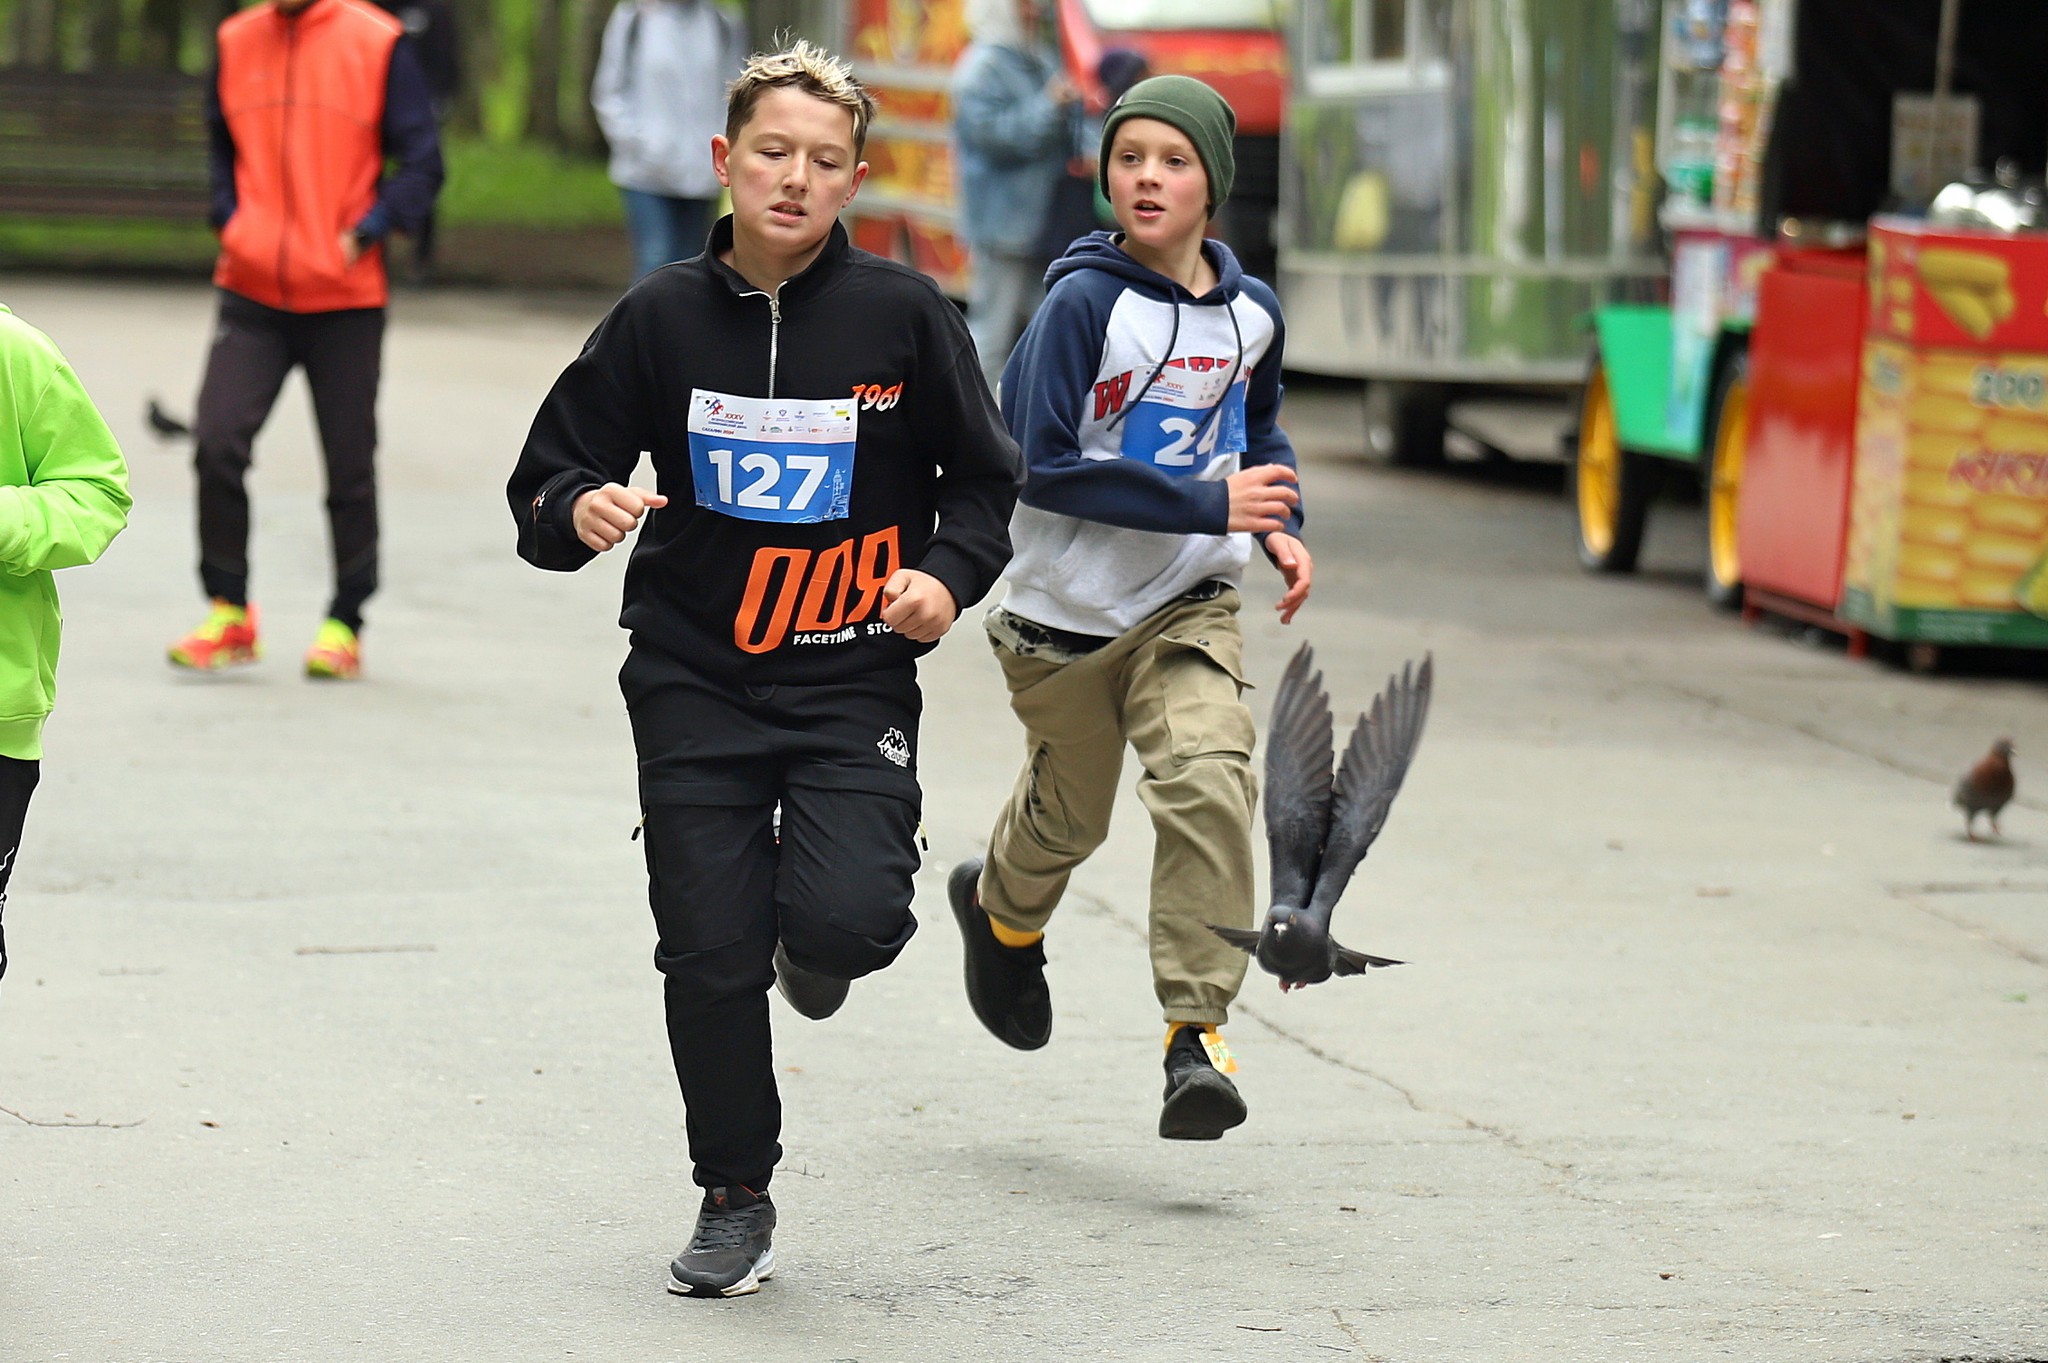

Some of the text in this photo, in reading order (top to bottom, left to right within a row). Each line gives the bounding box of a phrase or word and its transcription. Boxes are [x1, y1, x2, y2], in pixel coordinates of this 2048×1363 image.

[1154, 408, 1222, 467] 24
[708, 449, 830, 511] 127
[793, 626, 857, 646] FACETIME
